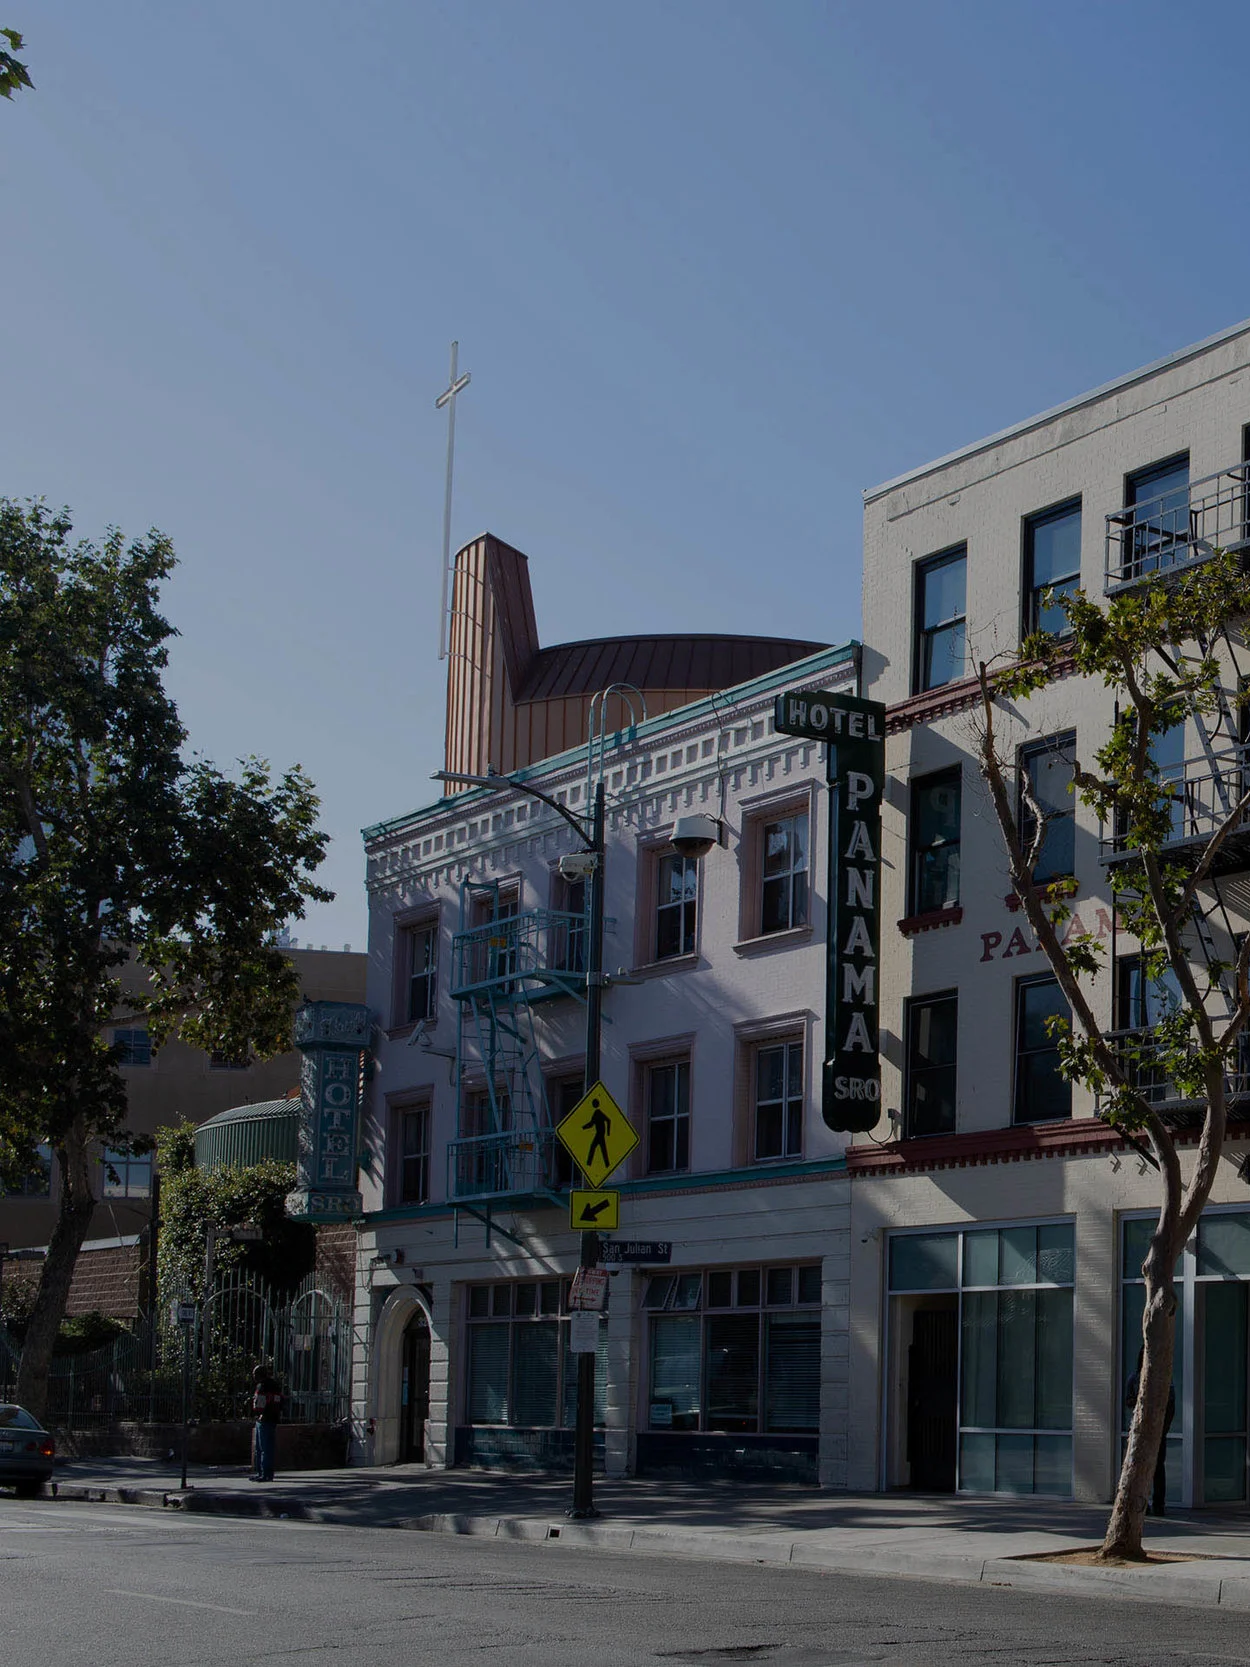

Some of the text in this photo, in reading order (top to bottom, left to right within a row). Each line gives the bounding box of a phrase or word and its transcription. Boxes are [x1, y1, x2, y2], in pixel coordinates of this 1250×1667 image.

[788, 698, 883, 741] HOTEL
[842, 771, 877, 1054] PANAMA
[834, 1076, 882, 1103] SRO
[322, 1056, 351, 1180] HOTEL
[603, 1242, 668, 1254] San Julian St
